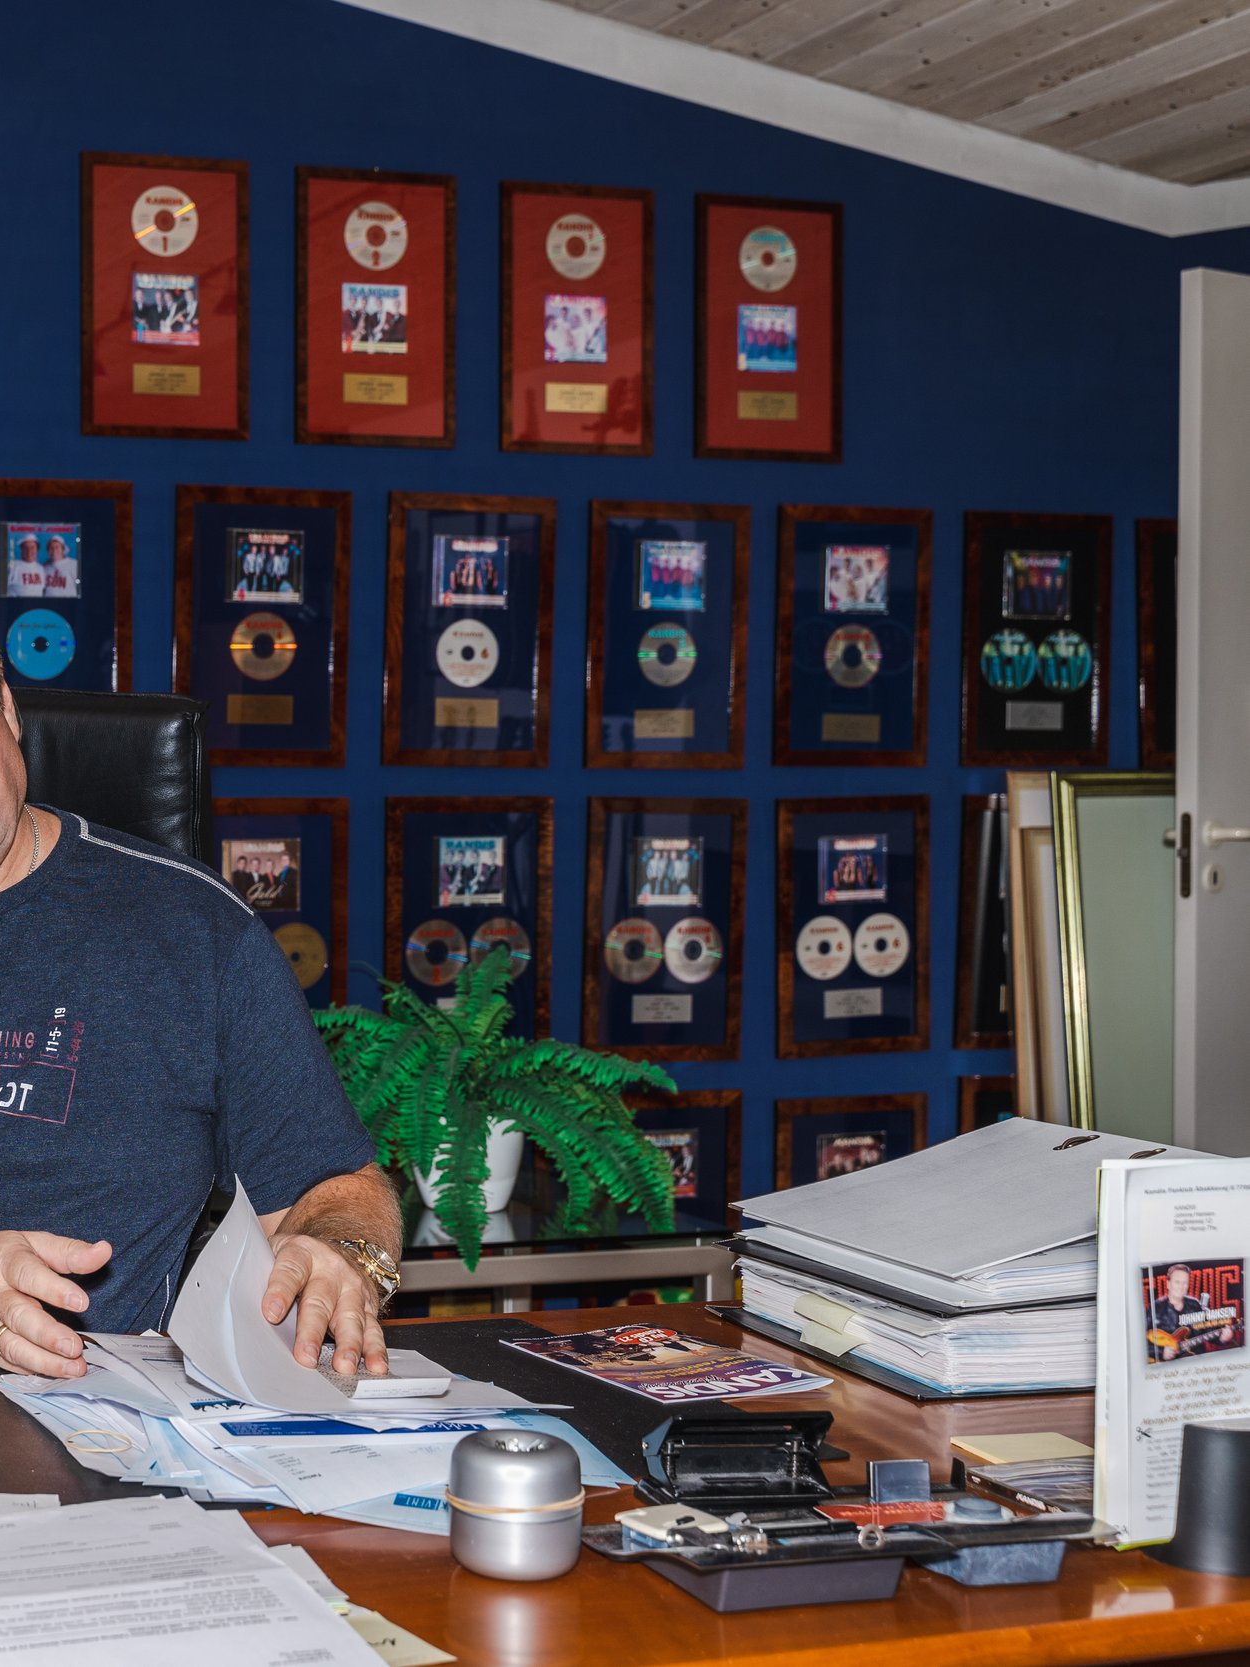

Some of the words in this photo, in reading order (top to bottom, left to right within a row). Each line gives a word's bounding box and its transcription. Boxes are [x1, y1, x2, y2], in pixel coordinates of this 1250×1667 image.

[481, 648, 489, 659] 6
[446, 840, 495, 851] KANDIS
[892, 937, 901, 949] 6
[1178, 1311, 1206, 1326] JOHNNY
[1206, 1306, 1237, 1321] HANSEN
[646, 1367, 803, 1399] KANDIS
